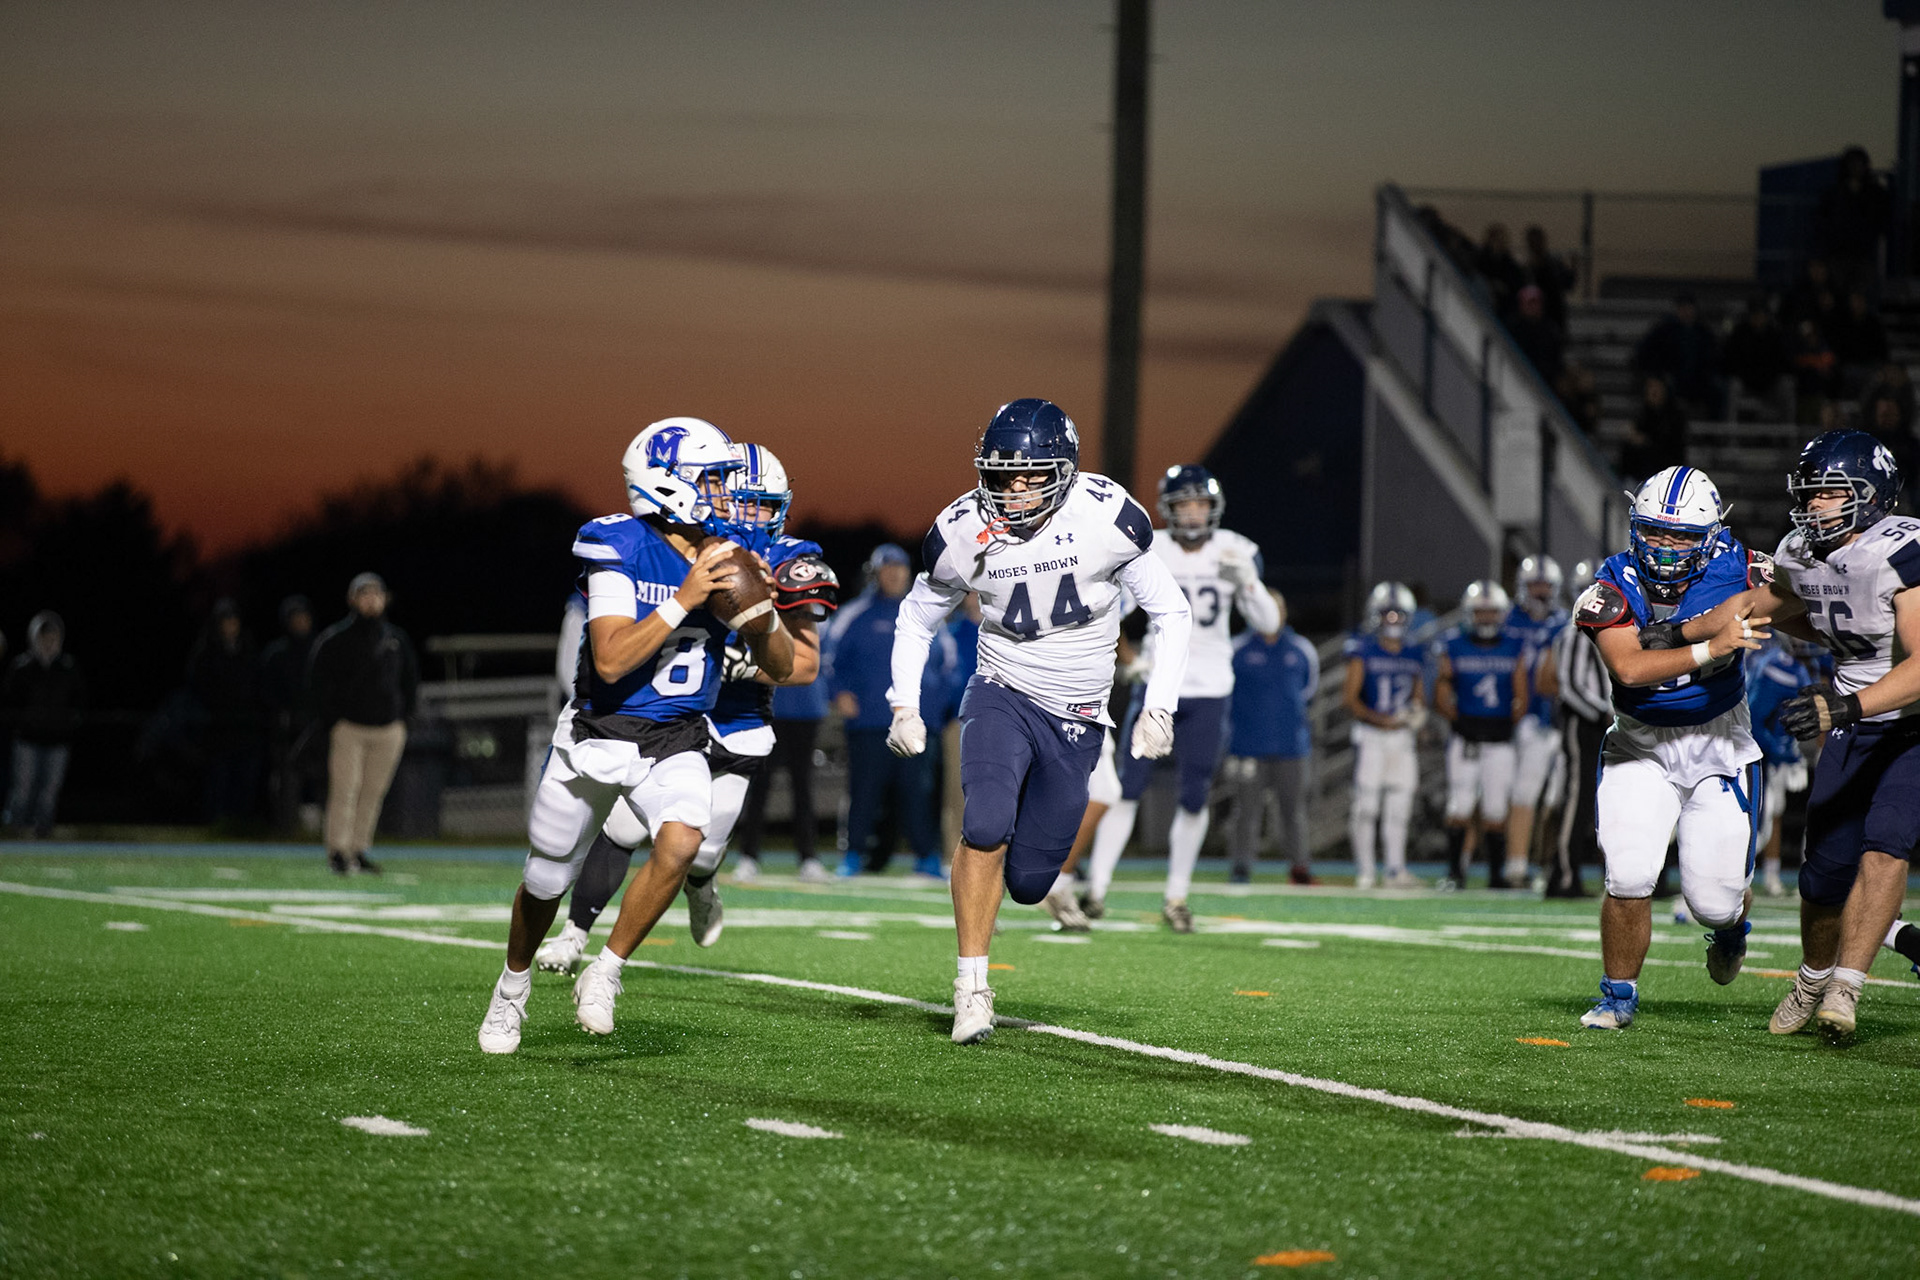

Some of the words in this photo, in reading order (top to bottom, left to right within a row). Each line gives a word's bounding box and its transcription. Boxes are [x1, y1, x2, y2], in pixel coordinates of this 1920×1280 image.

[648, 430, 685, 469] M
[1086, 477, 1115, 503] 44
[1881, 521, 1920, 542] 56
[987, 565, 1029, 580] MOSES
[1033, 555, 1079, 574] BROWN
[1822, 583, 1850, 596] BROWN
[1001, 572, 1095, 641] 44
[651, 625, 713, 697] 8
[1472, 673, 1501, 709] 4
